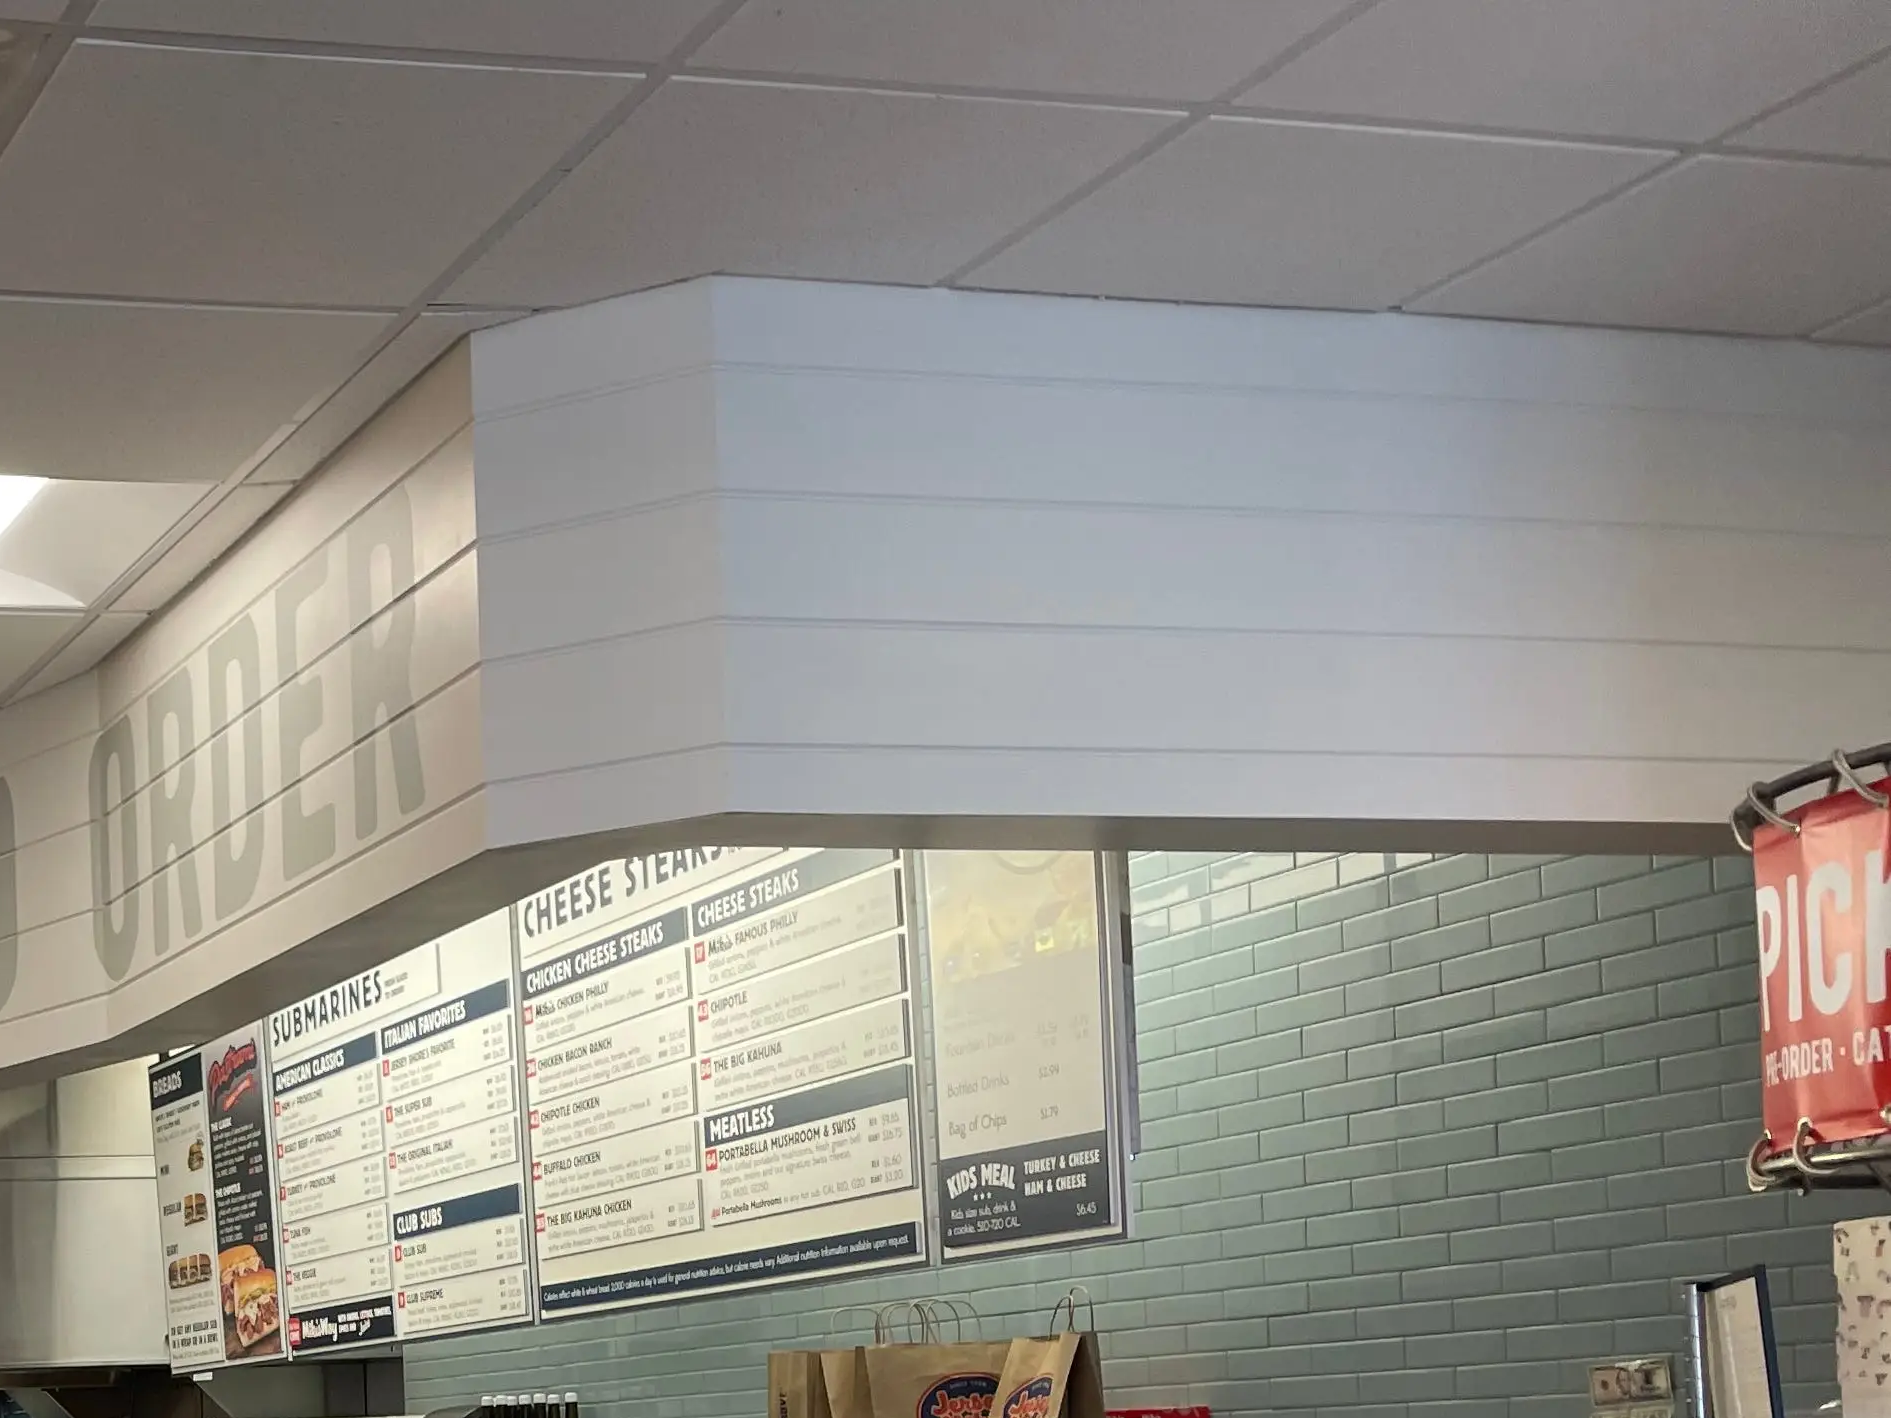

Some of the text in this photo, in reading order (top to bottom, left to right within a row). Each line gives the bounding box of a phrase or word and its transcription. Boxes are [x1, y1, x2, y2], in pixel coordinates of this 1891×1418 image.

[87, 480, 428, 984] ORDER
[524, 867, 612, 937] CHEESE
[697, 868, 800, 928] CHEESE STEAKS
[734, 921, 768, 944] FAMOUS
[769, 911, 799, 931] PHILLY
[526, 921, 663, 993] CHICKEN CHEESE STEAKS
[272, 970, 382, 1046] SUBMARINES
[557, 990, 584, 1009] CHICKEN
[585, 981, 609, 998] PHILLY
[710, 990, 748, 1014] CHIPOTLE
[383, 1000, 467, 1048] ITALIAN FAVORITES
[275, 1049, 345, 1091] AMERICAN CLASSICS
[537, 1038, 612, 1071] CHICKEN BACON RANCH
[713, 1041, 783, 1073] THE BIG KAHUNA
[1765, 1037, 1834, 1087] PRE-ORDER
[981, 1076, 1010, 1091] Drinks
[540, 1097, 600, 1124] CHIPOTLE CHICKEN
[709, 1104, 775, 1143] MEATLESS
[948, 1111, 1008, 1139] Bag of Chips
[719, 1117, 856, 1162] PORTABELLA MUSHROOM & SWISS
[543, 1151, 601, 1176] BUFFALO CHICKEN
[1023, 1148, 1101, 1175] TURKEY & CHEESE
[946, 1162, 1016, 1200] KIDS MEAL
[1024, 1173, 1087, 1197] HAM & CHEESE
[396, 1206, 443, 1234] CLUB SUBS
[546, 1214, 559, 1227] THE
[560, 1211, 572, 1225] BIG
[604, 1199, 632, 1217] CHICKEN
[931, 1390, 996, 1416] Jerse
